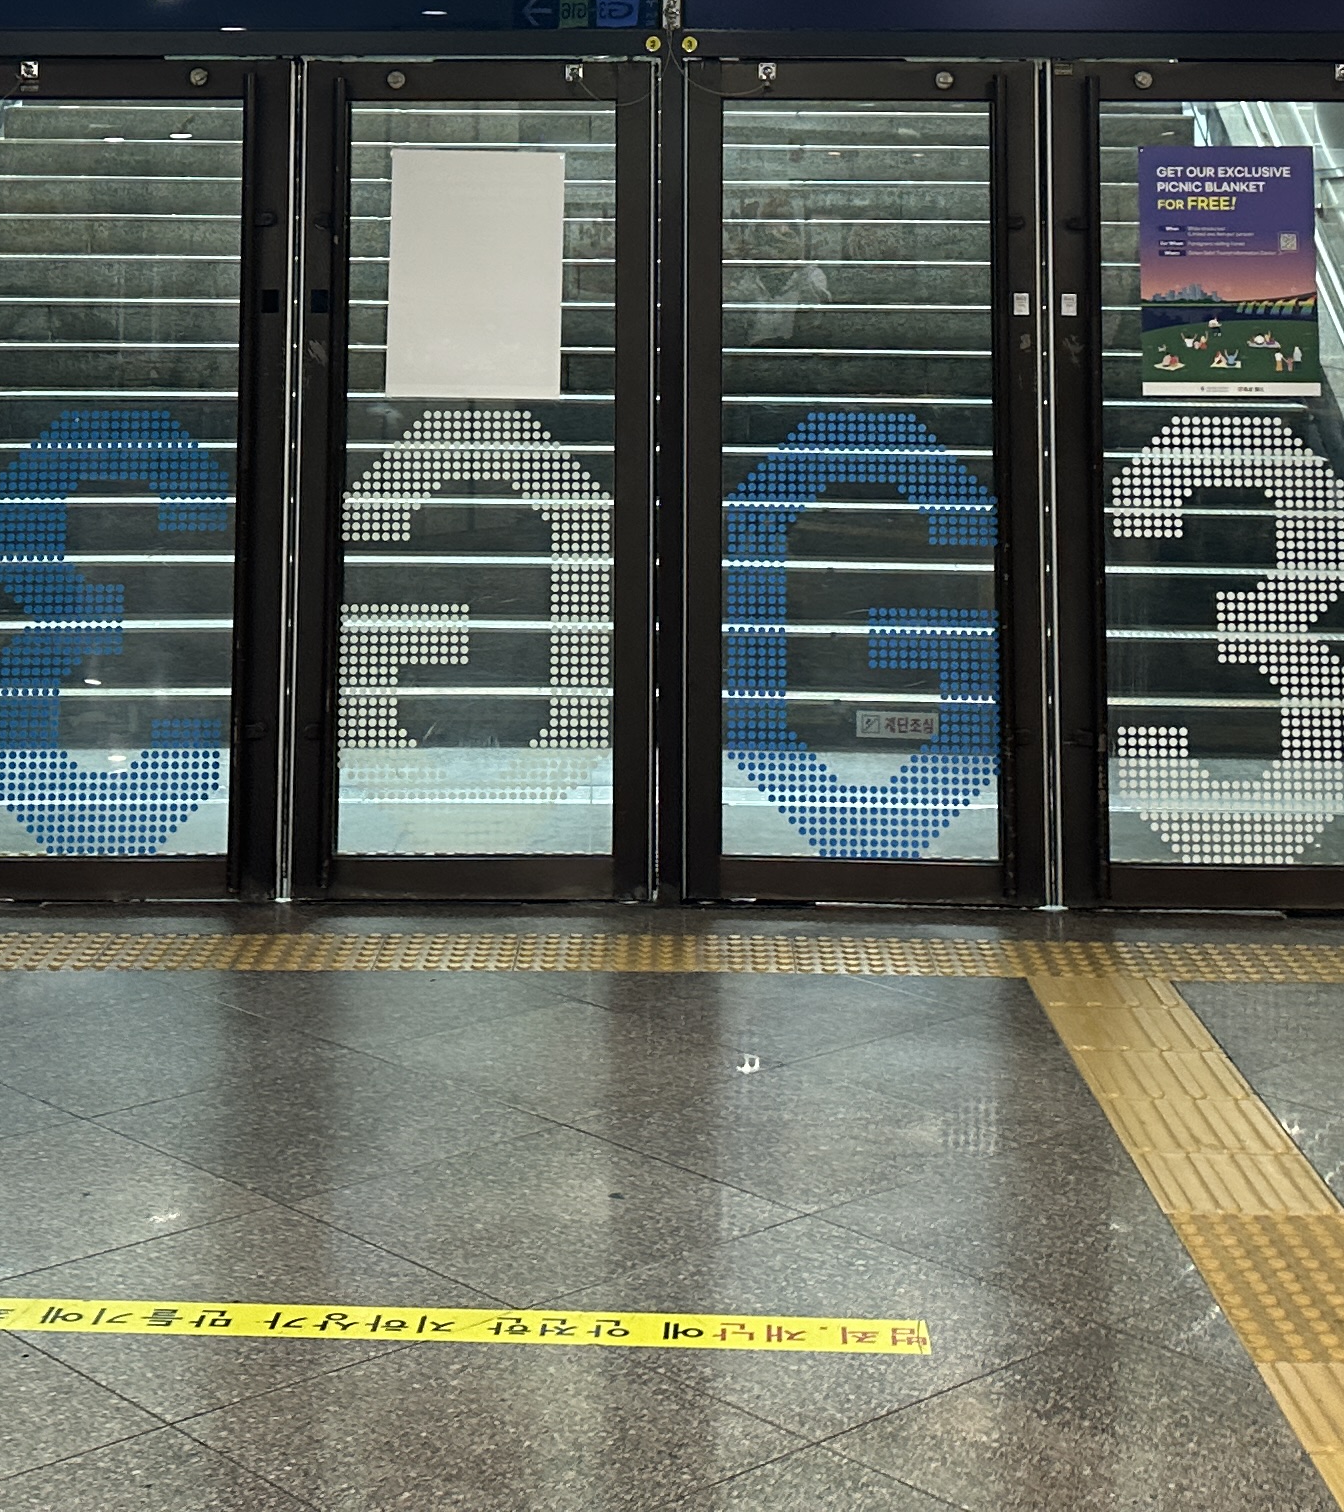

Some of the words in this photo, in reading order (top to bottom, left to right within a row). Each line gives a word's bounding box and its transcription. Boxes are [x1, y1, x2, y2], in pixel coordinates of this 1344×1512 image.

[1156, 166, 1184, 178] GET
[1186, 166, 1215, 178] OUR
[1217, 166, 1292, 178] EXCLUSIVE
[1156, 181, 1203, 193] PICNIC
[1205, 181, 1266, 193] BLANKET
[1157, 200, 1185, 210] FOR
[1187, 196, 1237, 211] FREE!
[884, 716, 934, 735] 계단조심
[40, 1307, 233, 1328] 만들기에
[264, 1311, 456, 1335] 지하상가
[488, 1316, 631, 1339] 안전한
[662, 1320, 808, 1343] 재난에
